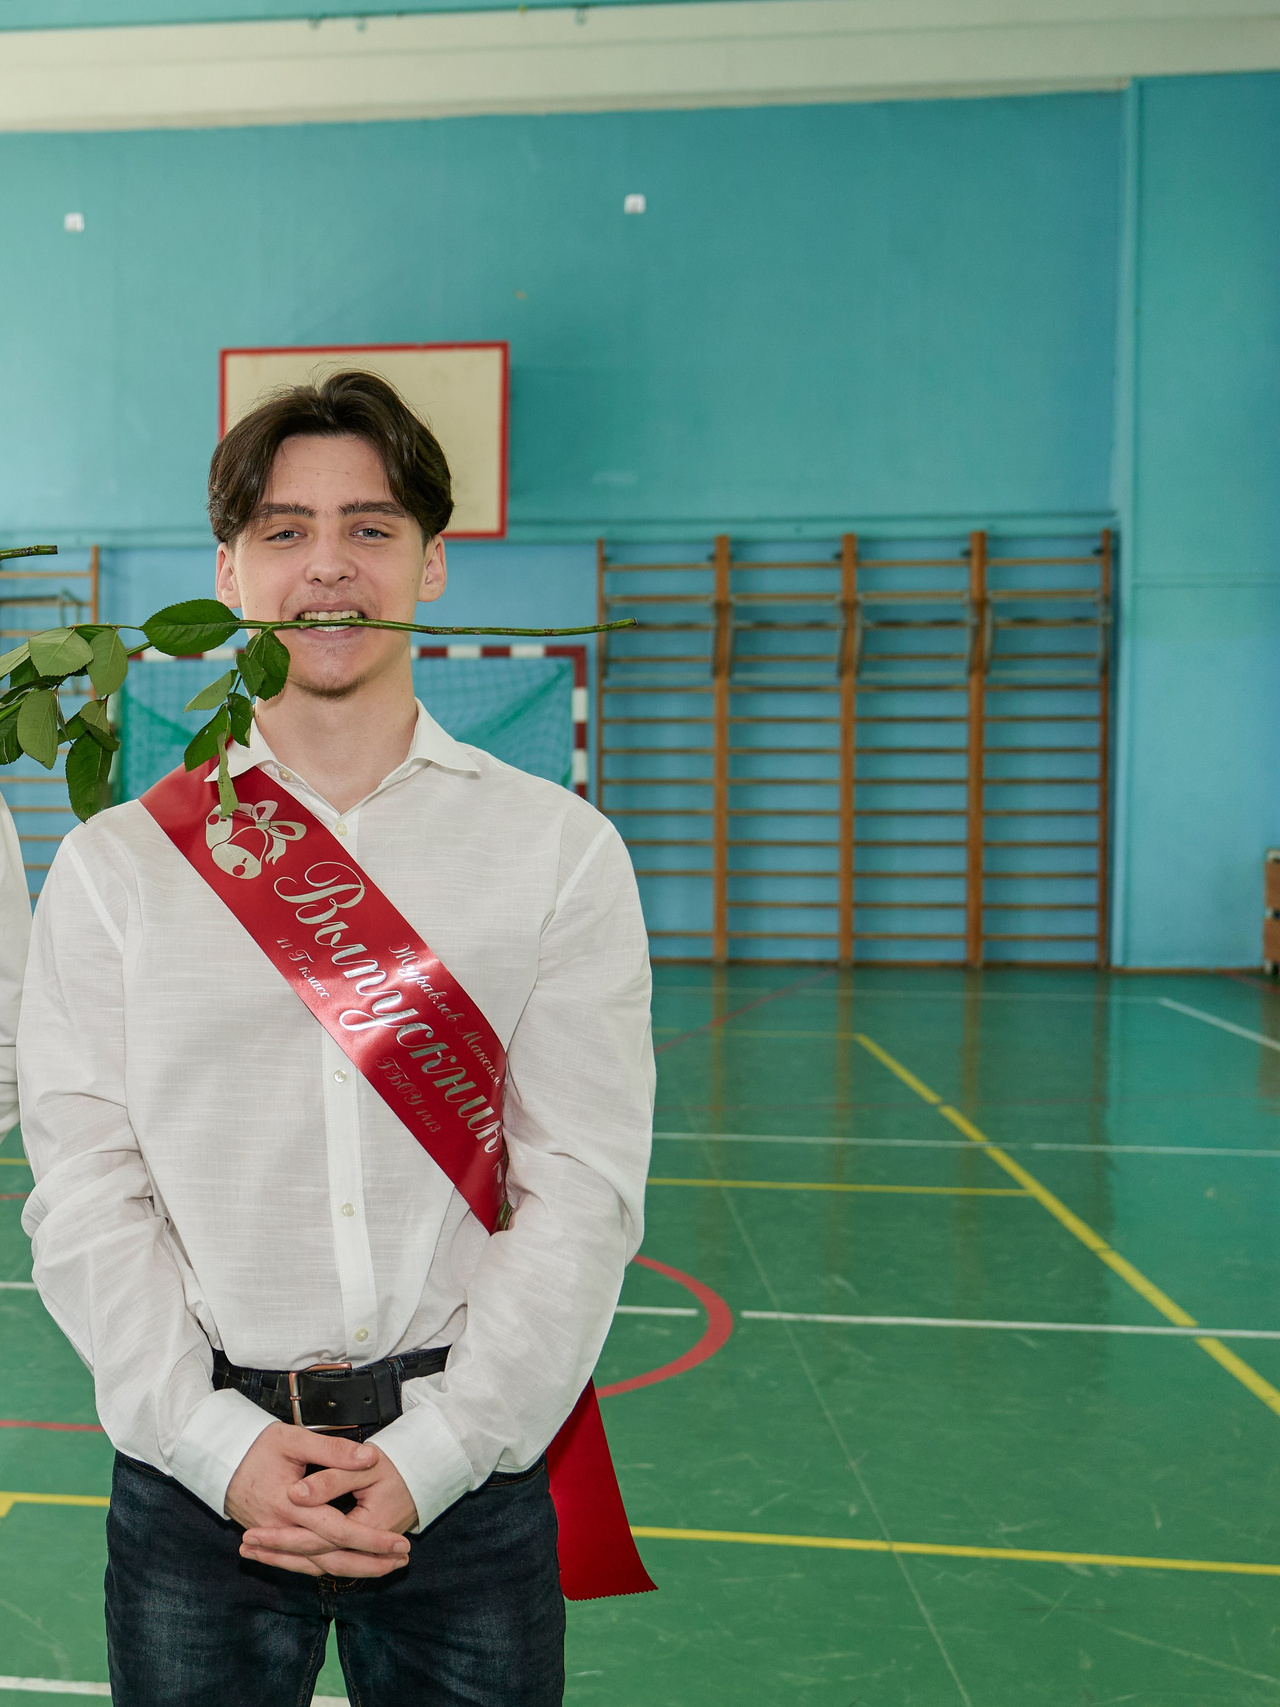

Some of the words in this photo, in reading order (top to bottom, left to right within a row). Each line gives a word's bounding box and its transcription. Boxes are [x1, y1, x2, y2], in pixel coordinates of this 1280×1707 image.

[276, 937, 293, 949] 11
[288, 949, 314, 963] Г
[273, 861, 503, 1154] Выпускник
[298, 966, 330, 1000] класс
[388, 942, 464, 1022] Журавлев
[455, 1026, 501, 1088] Максим
[375, 1056, 426, 1106] ГБОУ
[415, 1107, 442, 1133] 1413
